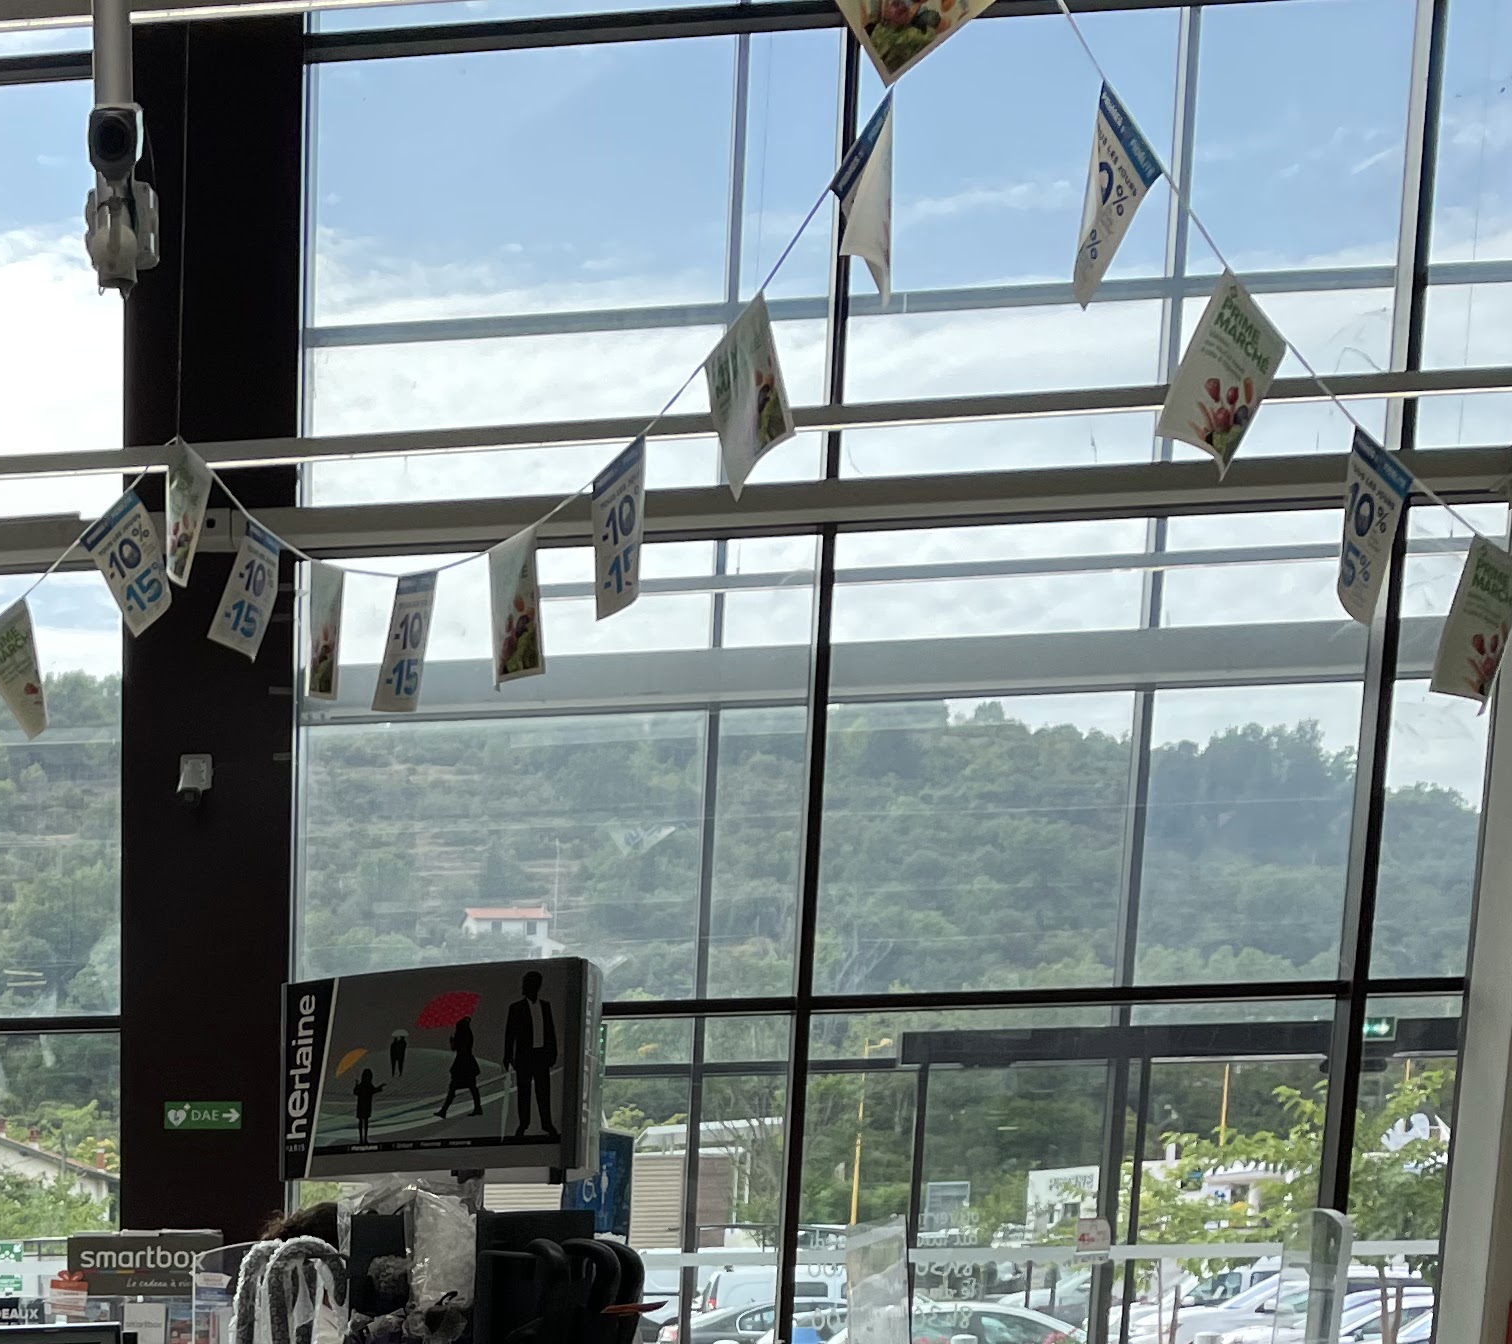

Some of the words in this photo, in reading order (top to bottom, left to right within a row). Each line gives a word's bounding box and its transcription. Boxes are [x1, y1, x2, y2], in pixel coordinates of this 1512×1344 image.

[1214, 312, 1270, 374] MARCHÉ
[1222, 298, 1262, 345] PRIME
[109, 524, 150, 579] -10%
[286, 994, 316, 1141] herlaine
[190, 1109, 220, 1121] DAE
[80, 1245, 206, 1271] smartbox
[126, 1278, 137, 1288] Le
[138, 1279, 168, 1288] cadeau
